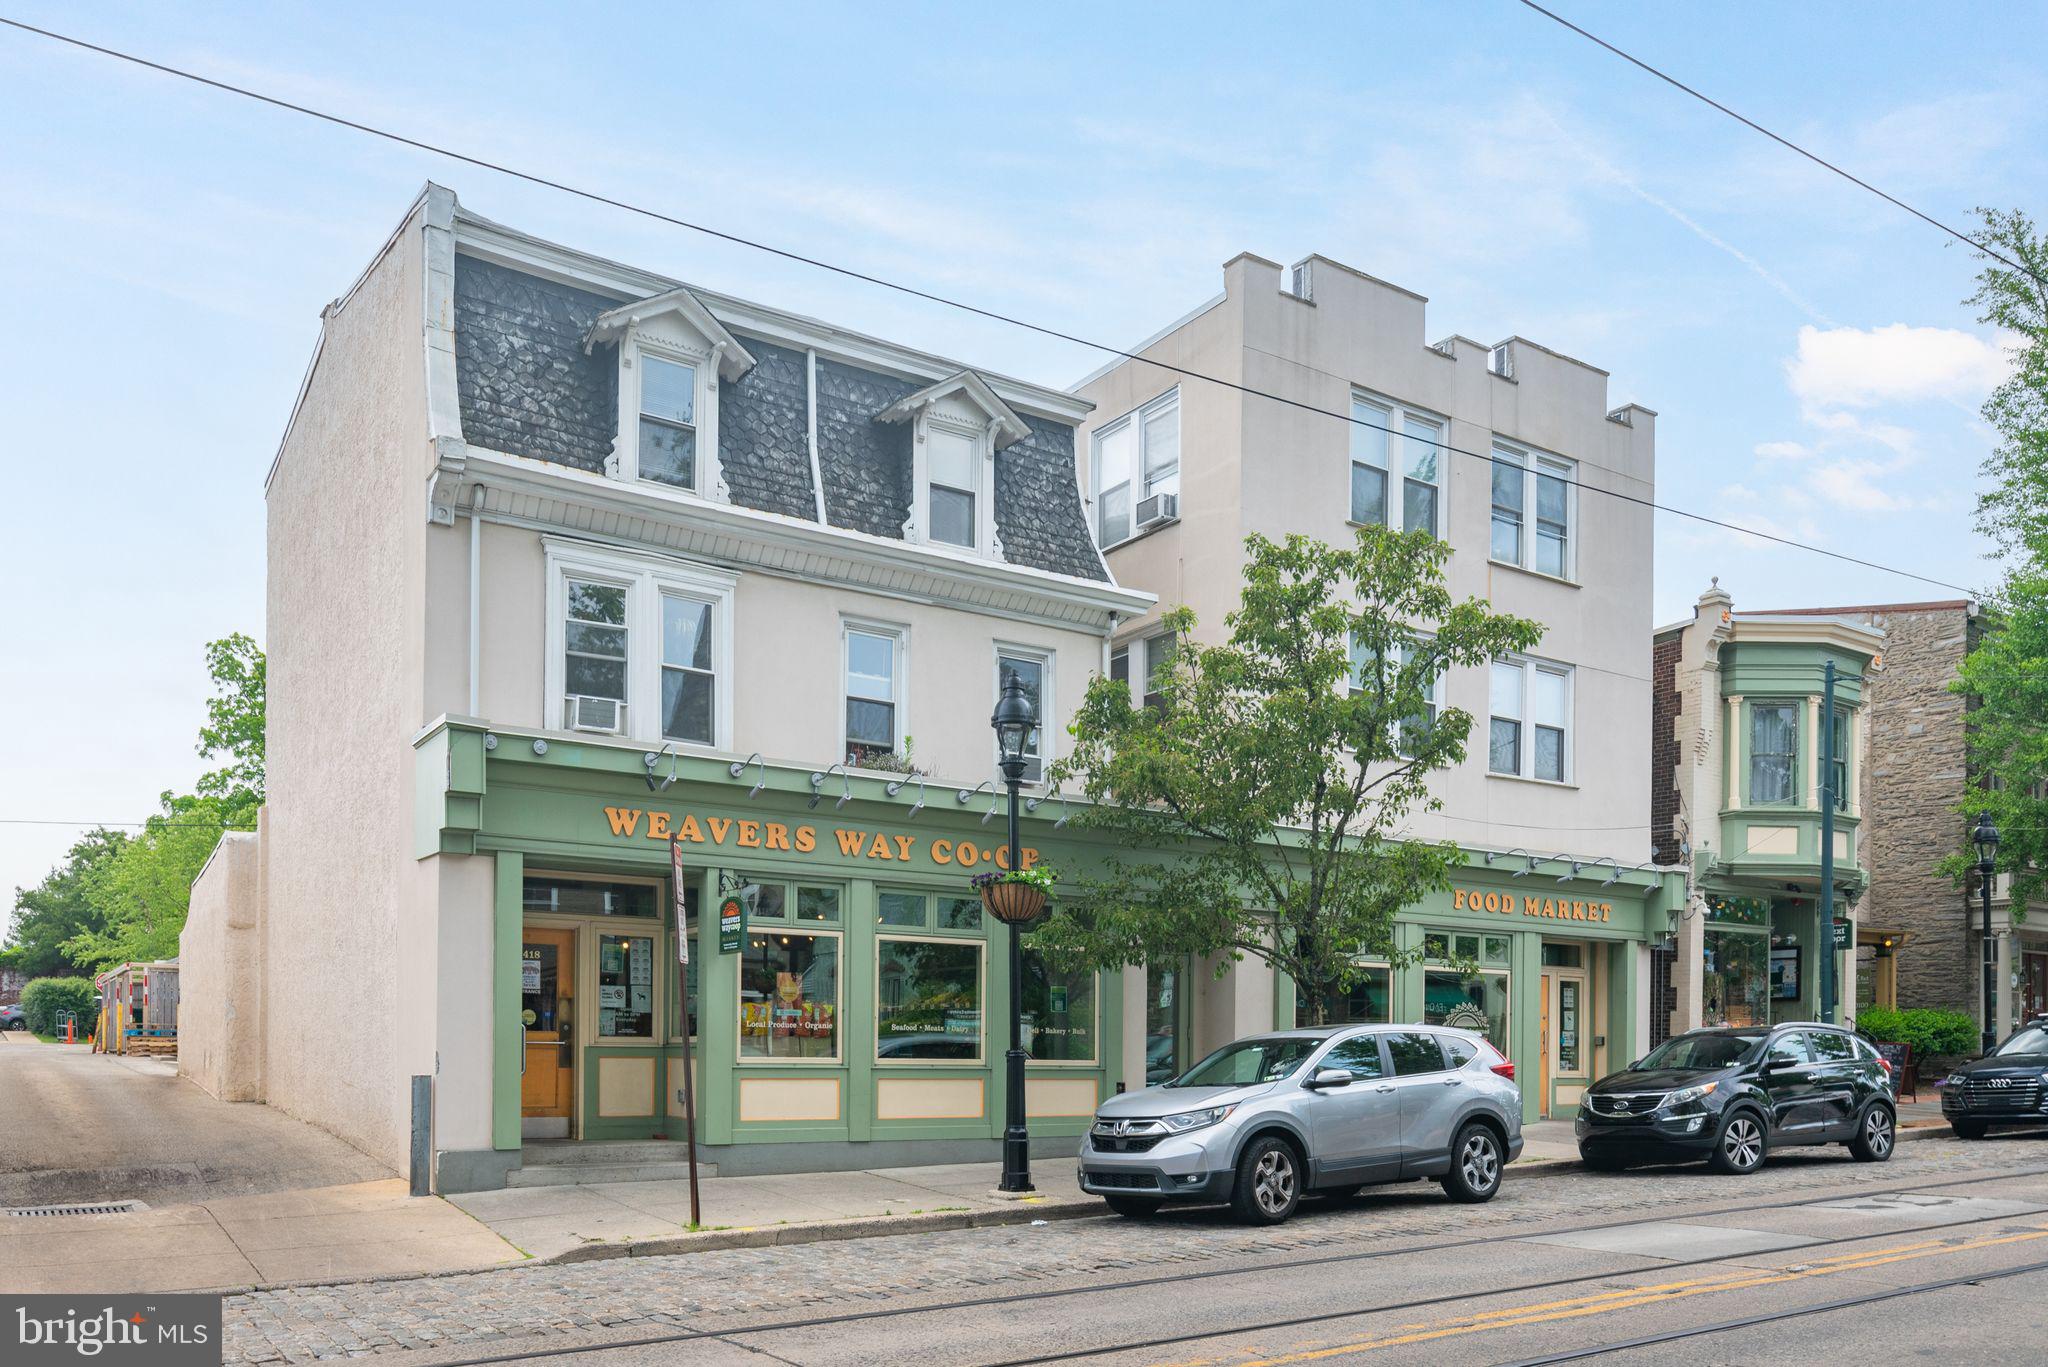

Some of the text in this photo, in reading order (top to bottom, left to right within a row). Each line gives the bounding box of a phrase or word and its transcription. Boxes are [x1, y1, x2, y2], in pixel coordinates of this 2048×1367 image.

[604, 807, 816, 852] WEAVERS
[834, 828, 915, 862] WAY
[1454, 889, 1612, 922] FOOD MARKET
[1833, 927, 1845, 935] ext
[746, 1020, 766, 1028] Local
[804, 1021, 833, 1030] Organic
[891, 1023, 969, 1033] Seafood Meats Dairy
[1045, 1027, 1067, 1036] Bakery
[1072, 1027, 1087, 1035] Bulk
